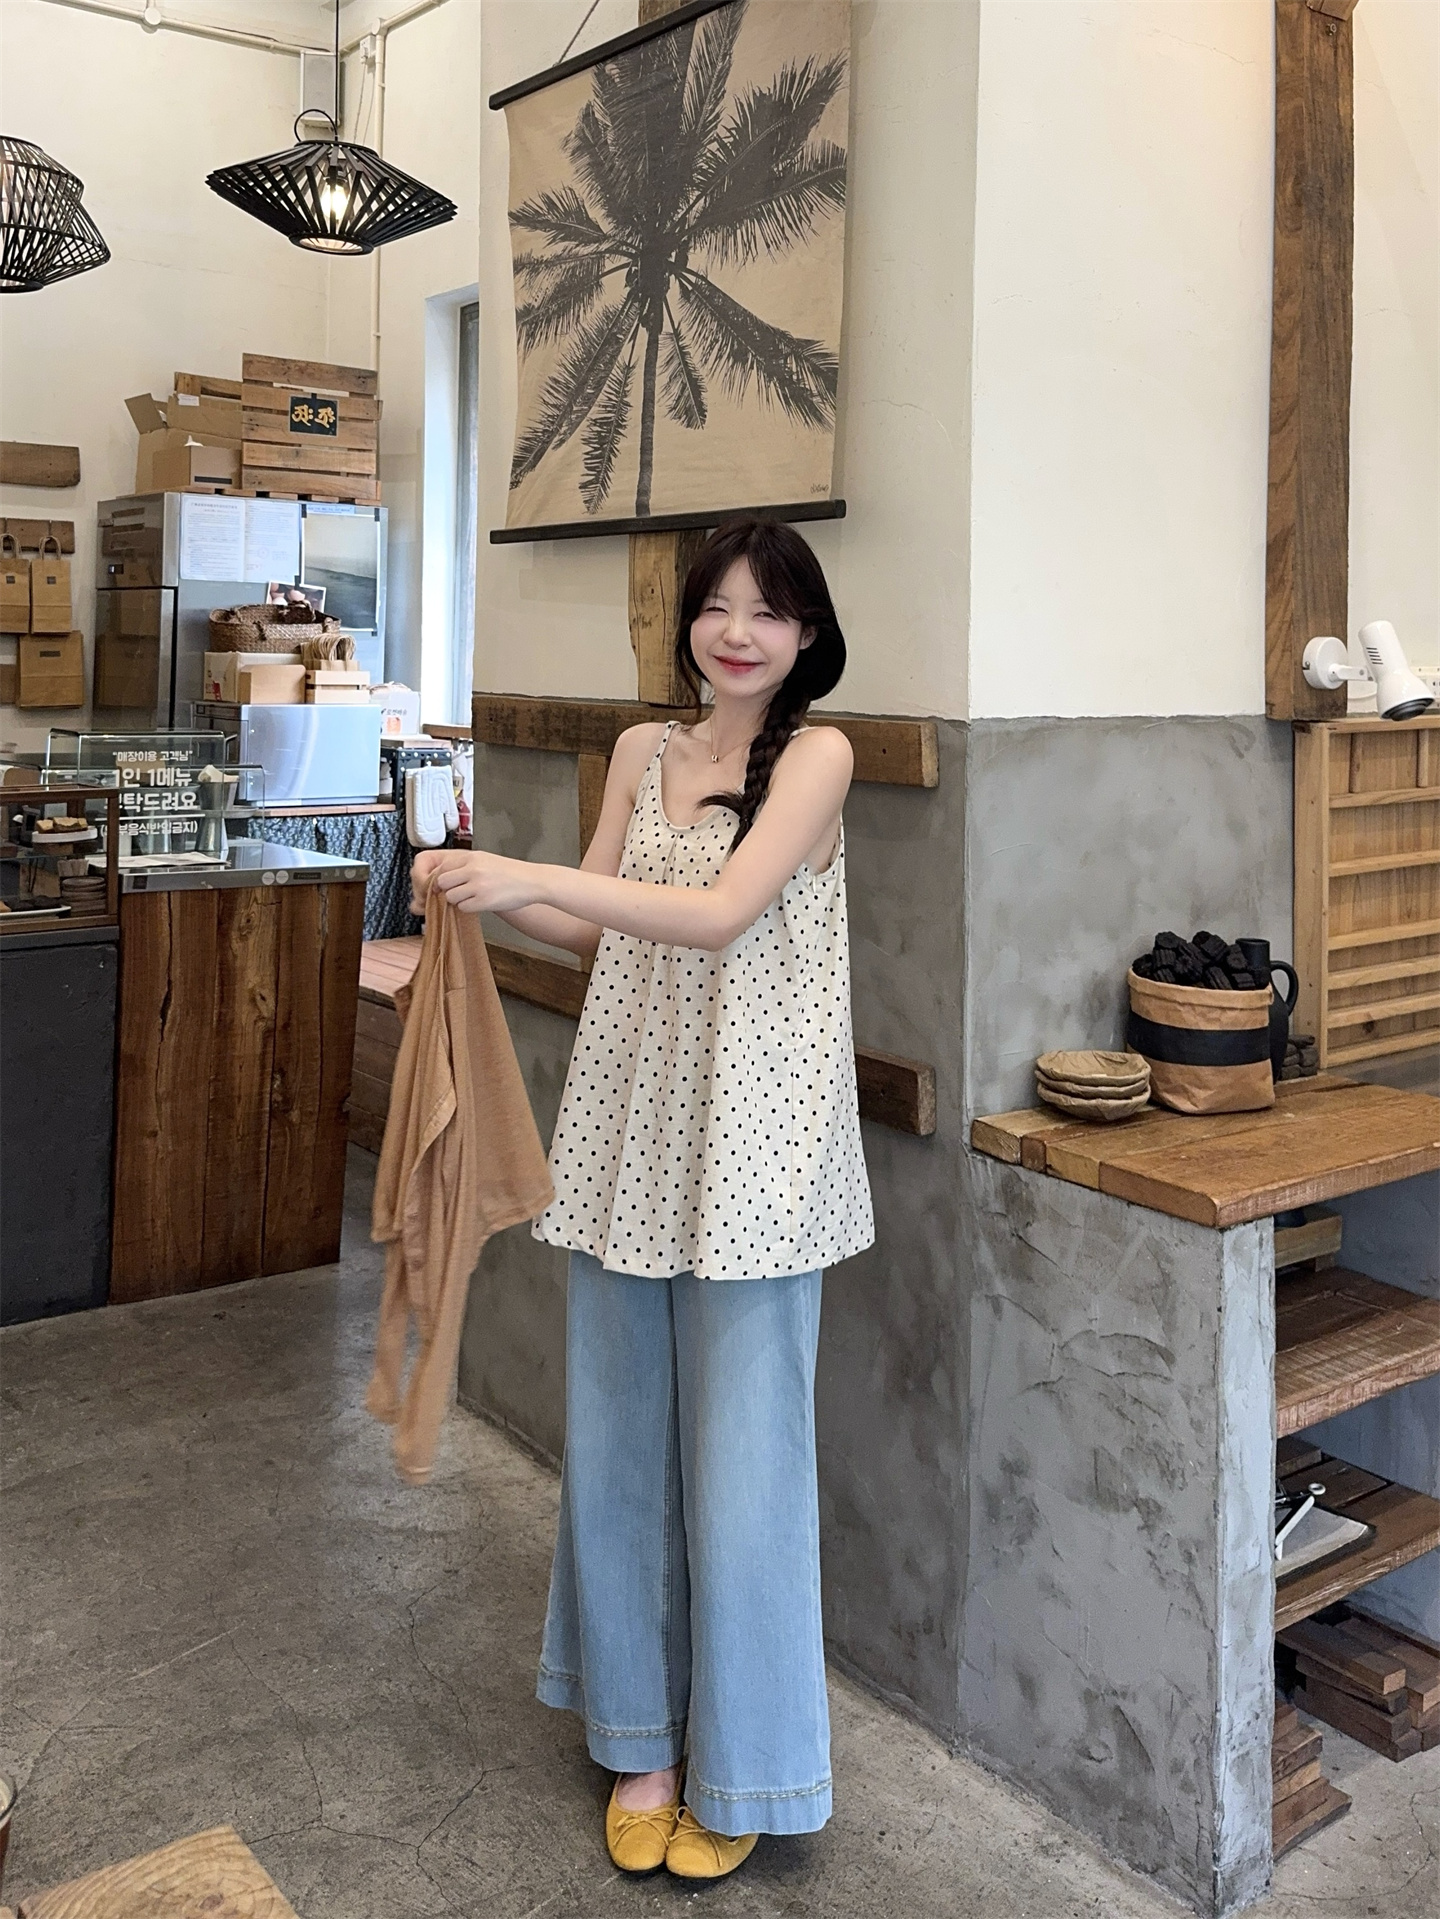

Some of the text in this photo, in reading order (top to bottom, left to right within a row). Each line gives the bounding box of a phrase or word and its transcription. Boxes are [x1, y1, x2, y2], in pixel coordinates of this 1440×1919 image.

[112, 767, 192, 788] 1인 1메뉴
[104, 792, 198, 813] 탁드려요
[101, 821, 198, 836] (부음식반입금지)
